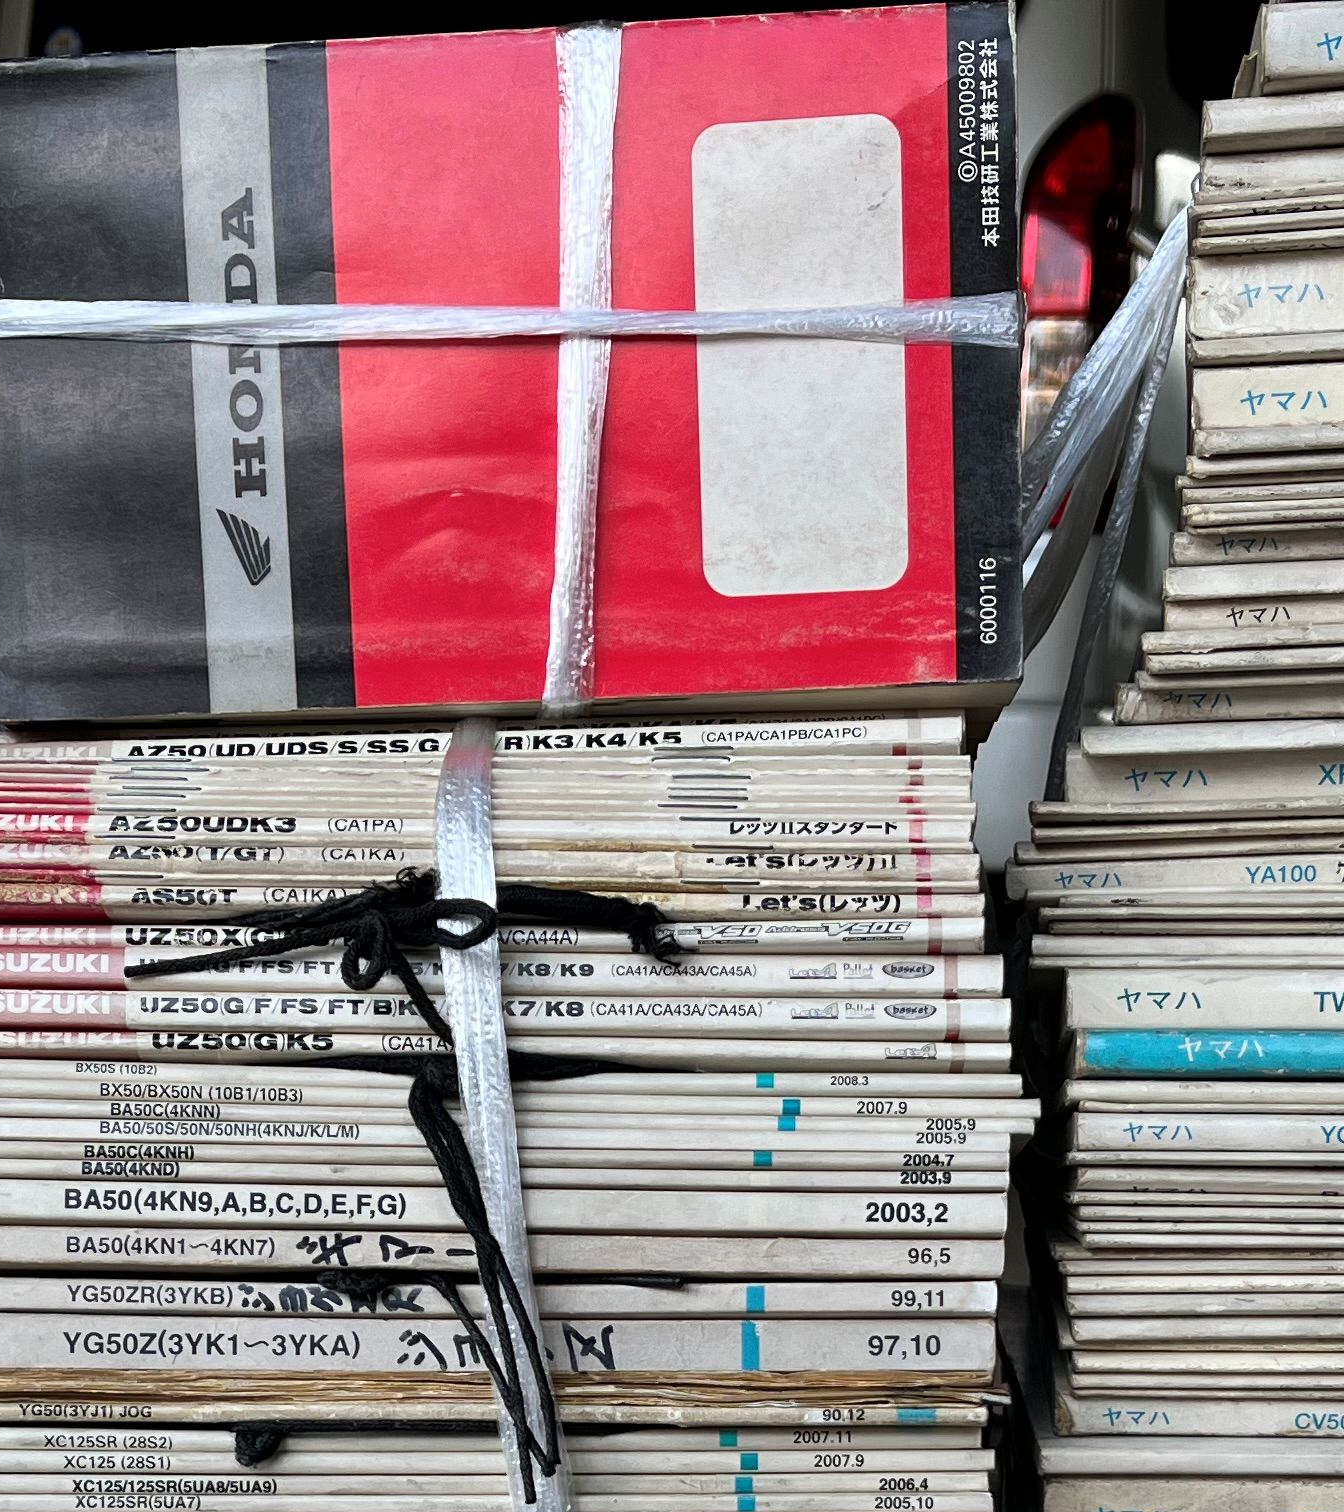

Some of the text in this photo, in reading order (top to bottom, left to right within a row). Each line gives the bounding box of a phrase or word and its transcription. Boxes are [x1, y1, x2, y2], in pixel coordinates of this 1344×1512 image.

[979, 37, 1000, 247] 本田技研工業株式会社
[1238, 282, 1325, 309] ヤマハ
[1240, 389, 1329, 415] ヤマハ
[979, 557, 1000, 646] 6000116
[1226, 606, 1290, 625] ヤマハ
[1125, 767, 1209, 789] ヤマハ
[1054, 865, 1317, 887] ヤマハ YA100
[1117, 990, 1202, 1011] ヤマハ
[99, 1083, 203, 1100] BX50/BX50N
[856, 1101, 907, 1115] 2007.9
[1124, 1123, 1193, 1142] ヤマハ
[119, 1404, 152, 1418] JOG
[43, 1435, 117, 1449] XC125SR
[63, 1455, 117, 1469] XC125
[814, 1454, 865, 1468] 2007.9
